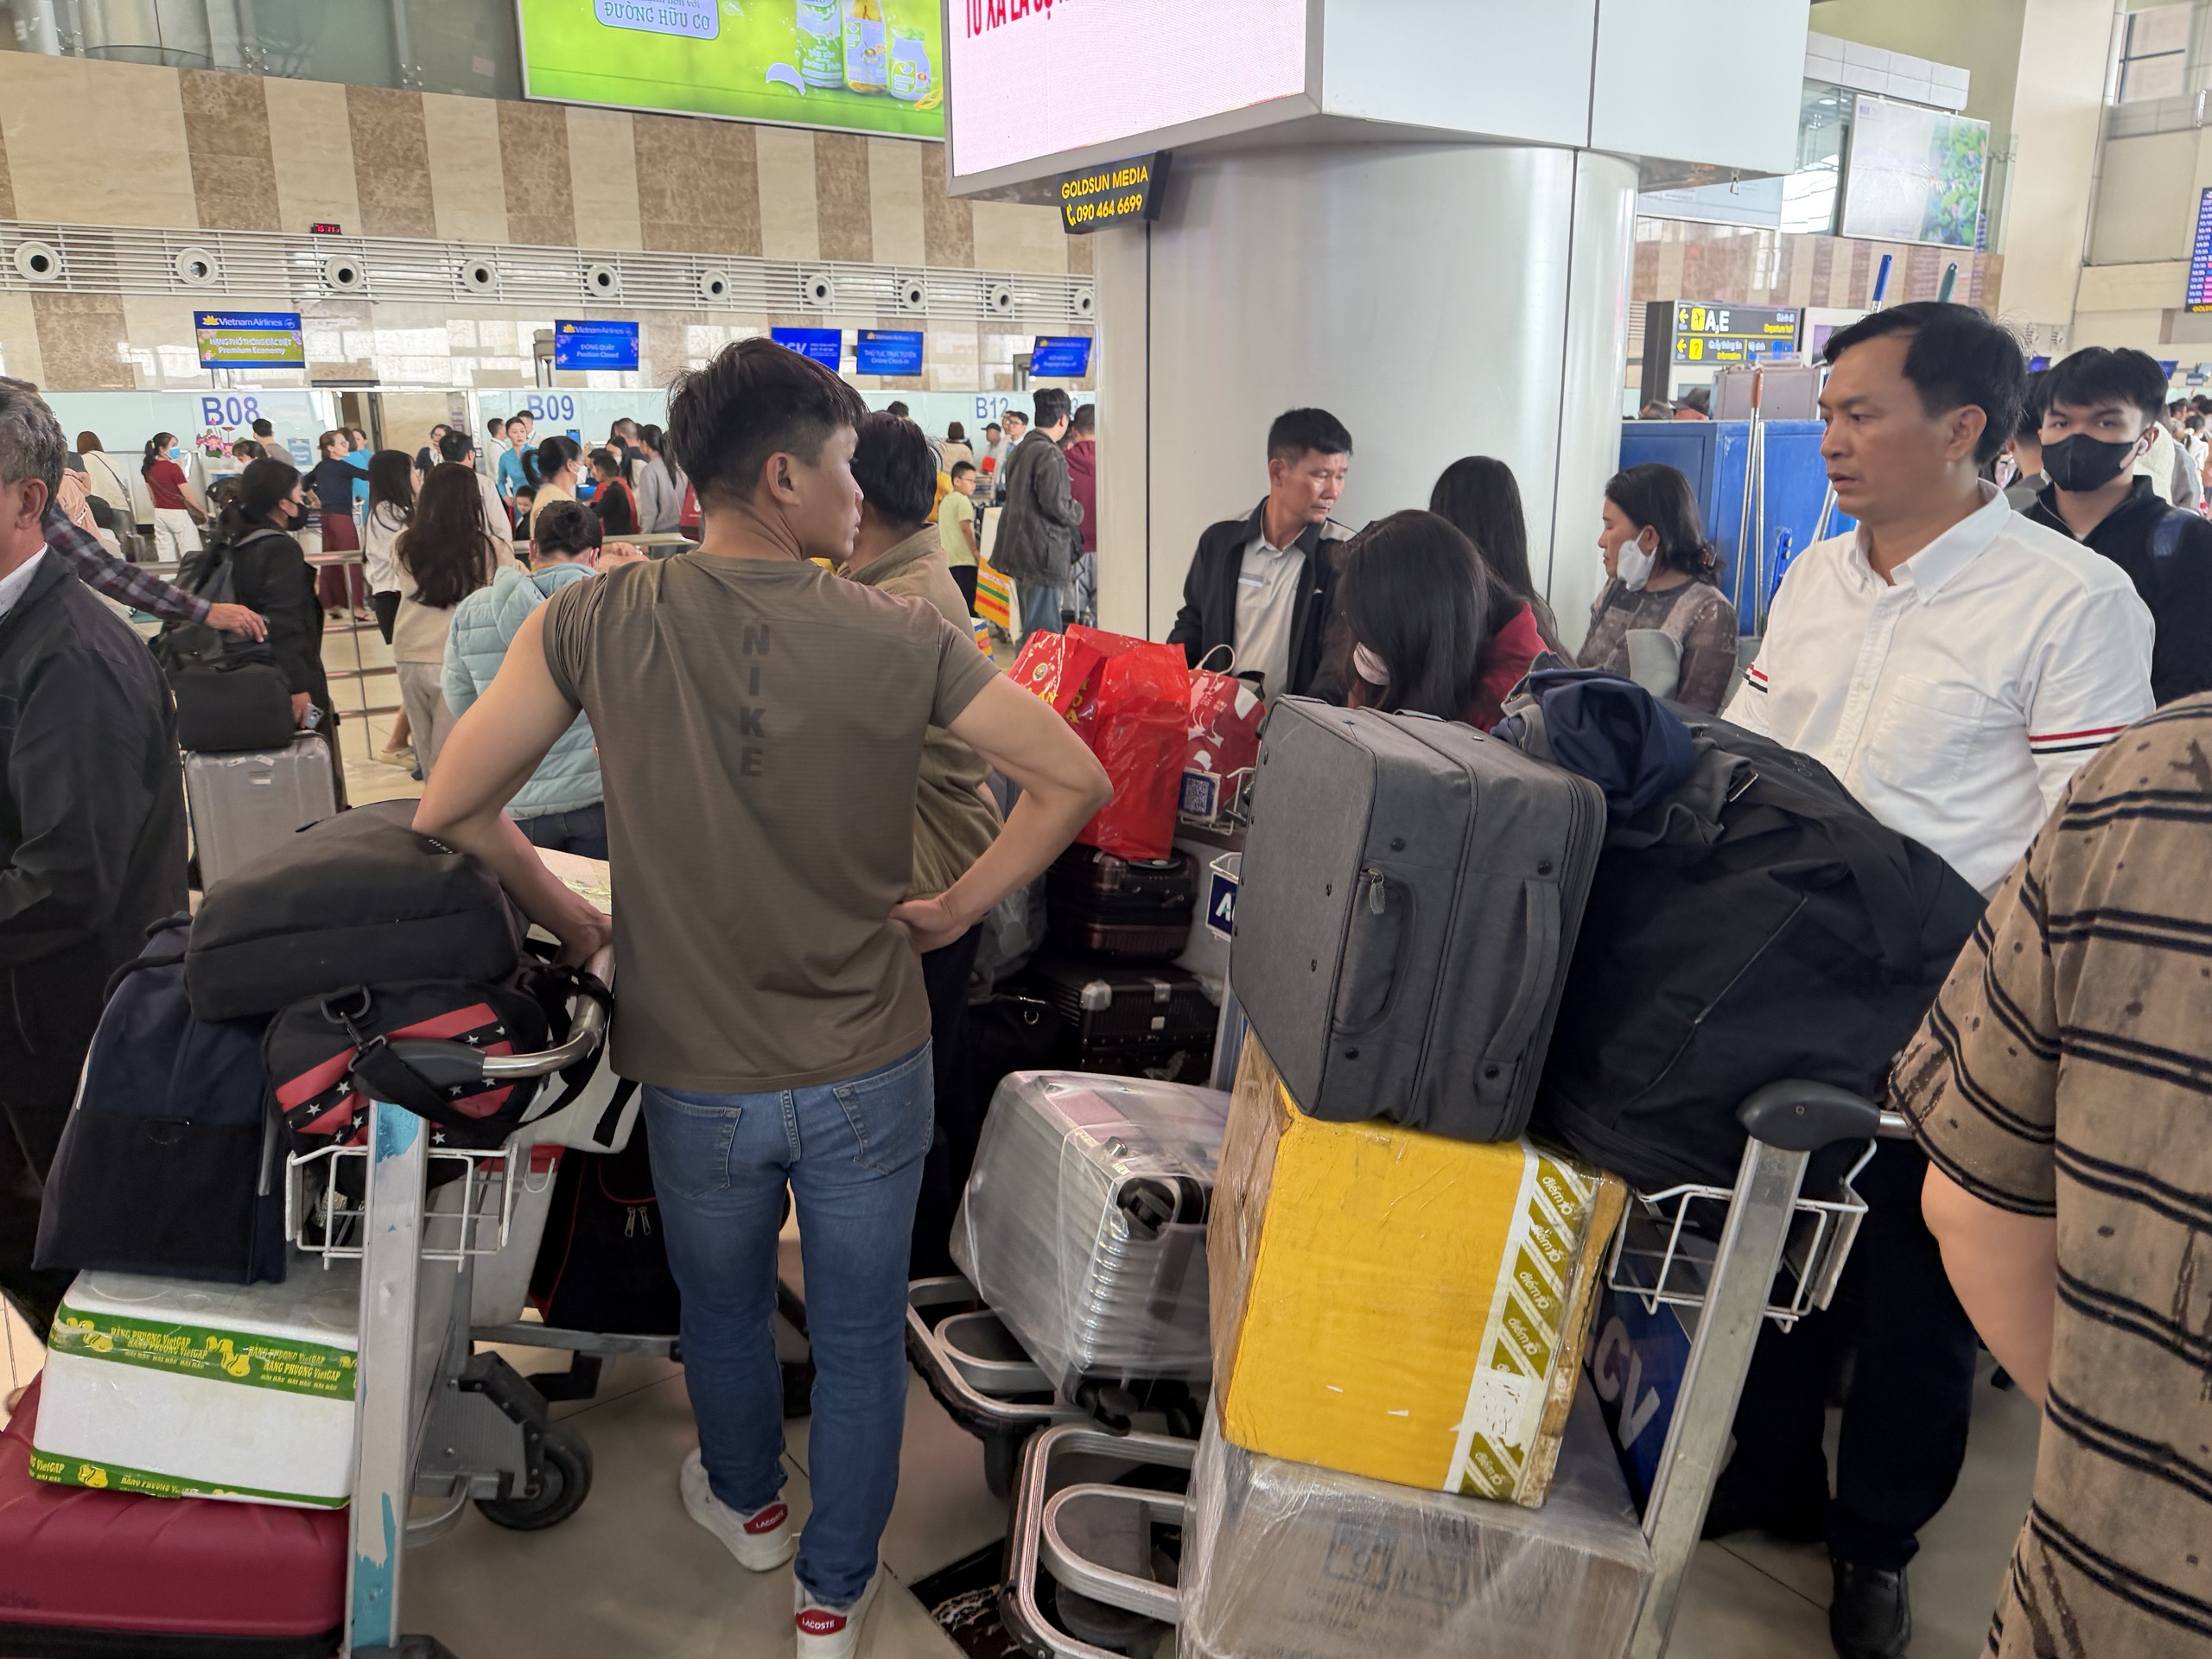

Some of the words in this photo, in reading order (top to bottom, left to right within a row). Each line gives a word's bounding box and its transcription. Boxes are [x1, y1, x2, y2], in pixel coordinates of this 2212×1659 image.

[605, 2, 654, 22] ĐƯỜNG
[658, 8, 688, 28] HỮU
[693, 14, 710, 30] CƠ
[1061, 174, 1110, 200] GOLDSUN
[1112, 165, 1148, 189] MEDIA
[1076, 203, 1095, 223] 090
[1096, 200, 1115, 218] 464
[1117, 194, 1142, 215] 6699
[251, 346, 286, 355] Economy
[201, 397, 260, 426] B08
[527, 395, 575, 421] B09
[976, 397, 1009, 419] B12
[741, 623, 771, 778] NIKE
[756, 1510, 785, 1529] LACOSTE
[802, 1617, 836, 1630] LACOSTE
